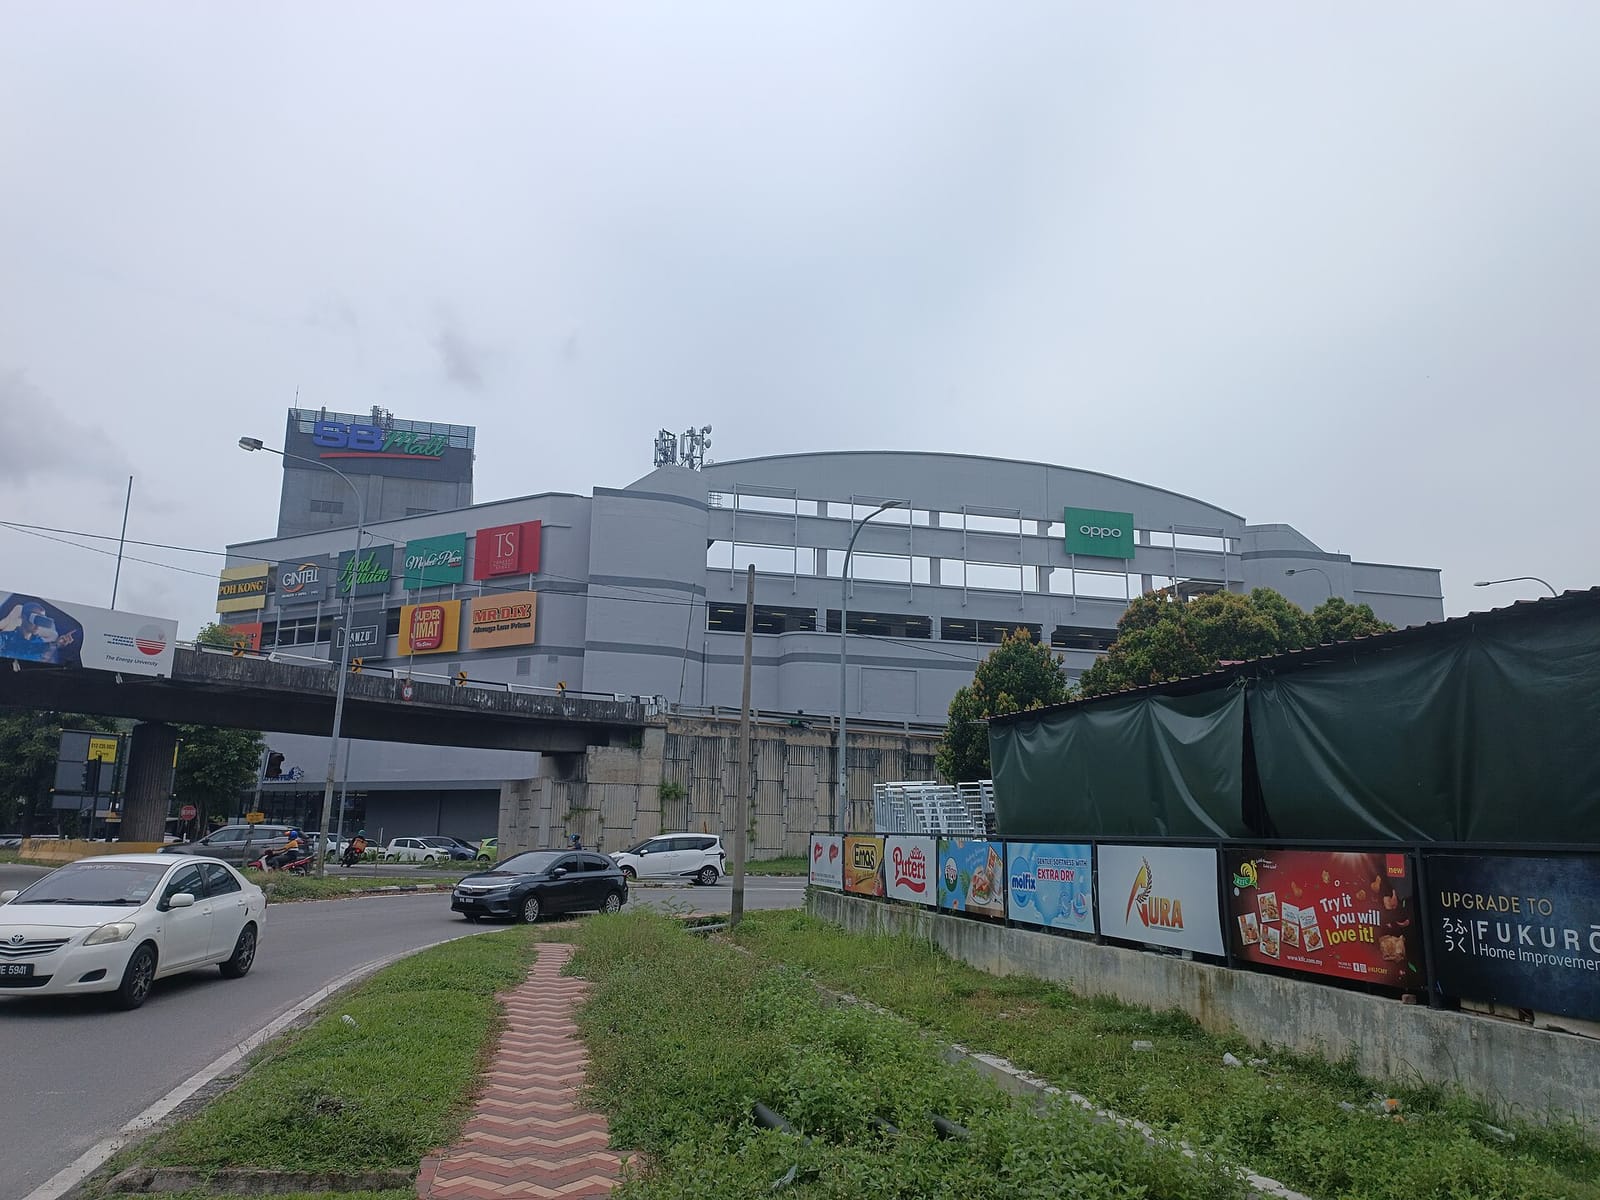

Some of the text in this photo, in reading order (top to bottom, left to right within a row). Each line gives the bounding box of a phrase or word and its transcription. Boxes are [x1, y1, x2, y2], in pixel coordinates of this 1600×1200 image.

[313, 420, 449, 457] SB Mall
[1079, 525, 1122, 539] oppo
[495, 531, 515, 558] TS
[437, 549, 462, 566] Place
[282, 569, 320, 587] GINTELL
[219, 580, 264, 596] POH KONG
[415, 608, 440, 622] SUPER
[410, 620, 440, 639] JIMAT
[473, 624, 496, 634] Always
[497, 623, 510, 632] Low
[115, 655, 134, 664] Energy
[134, 658, 159, 667] University
[892, 846, 927, 880] Puteri
[1388, 867, 1403, 875] new
[1011, 873, 1036, 890] molfix
[1037, 868, 1075, 883] EXTRA DRY
[1320, 892, 1353, 913] Try it
[1440, 891, 1553, 916] UPGRADE TO
[1332, 911, 1356, 930] you
[1357, 910, 1381, 927] will
[1325, 924, 1376, 946] love it!
[1479, 943, 1516, 960] Home
[8, 965, 27, 975] 5941
